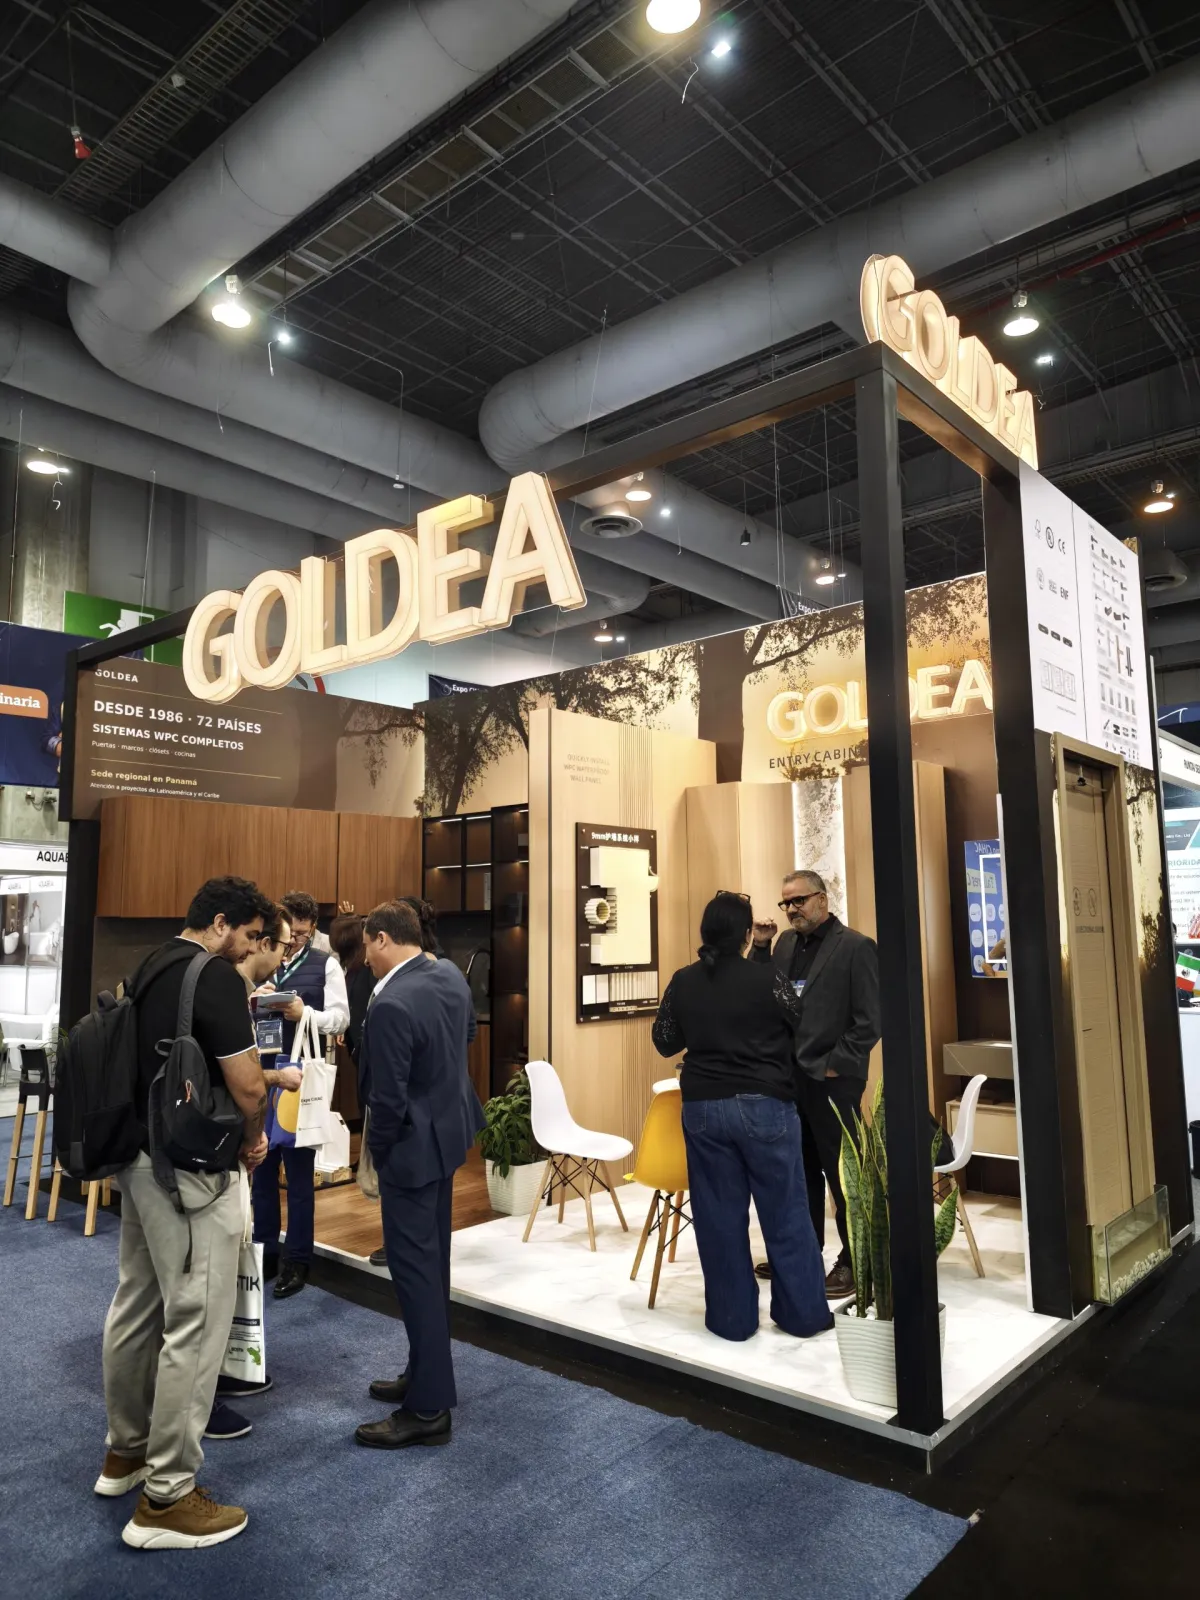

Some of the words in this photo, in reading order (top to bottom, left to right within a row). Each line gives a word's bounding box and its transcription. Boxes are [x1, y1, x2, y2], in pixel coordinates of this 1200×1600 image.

[860, 254, 1038, 471] GOLDEA
[182, 471, 587, 704] GOLDEA
[94, 668, 139, 683] GOLDEA
[452, 684, 469, 694] Expo
[0, 692, 41, 709] inaria
[94, 699, 144, 718] DESDE
[149, 708, 183, 723] 1986
[196, 715, 213, 728] 72
[217, 717, 262, 734] PAÍSES
[92, 723, 150, 739] SISTEMAS
[154, 731, 179, 742] WPC
[181, 735, 244, 750] COMPLETOS
[92, 740, 116, 749] Puertas
[121, 744, 144, 752] marcos
[149, 746, 170, 755] clósets
[174, 750, 196, 758] cocinas
[769, 752, 811, 769] ENTRY
[91, 769, 113, 778] Sede
[116, 773, 151, 781] regional
[166, 776, 197, 786] Panamá
[121, 785, 147, 793] proyectos
[157, 788, 192, 796] Latinoamérica
[237, 1275, 261, 1292] TIK
